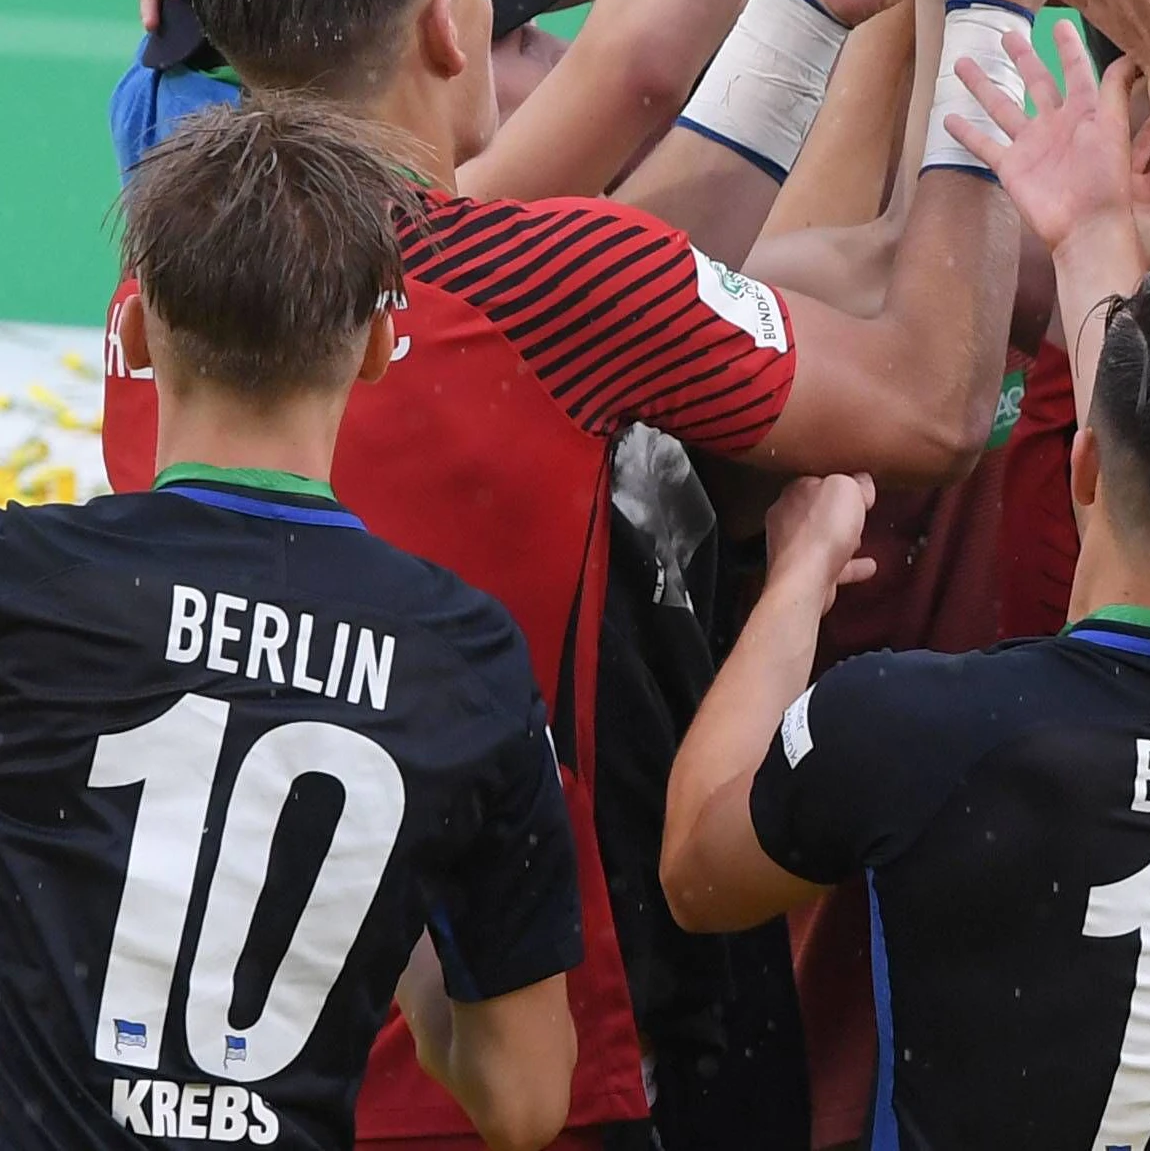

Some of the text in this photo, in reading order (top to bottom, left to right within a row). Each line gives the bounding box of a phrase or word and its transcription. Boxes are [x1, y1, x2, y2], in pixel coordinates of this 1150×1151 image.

[165, 584, 396, 711] BERLIN
[87, 692, 406, 1083] 10
[111, 1077, 280, 1146] KREBS
